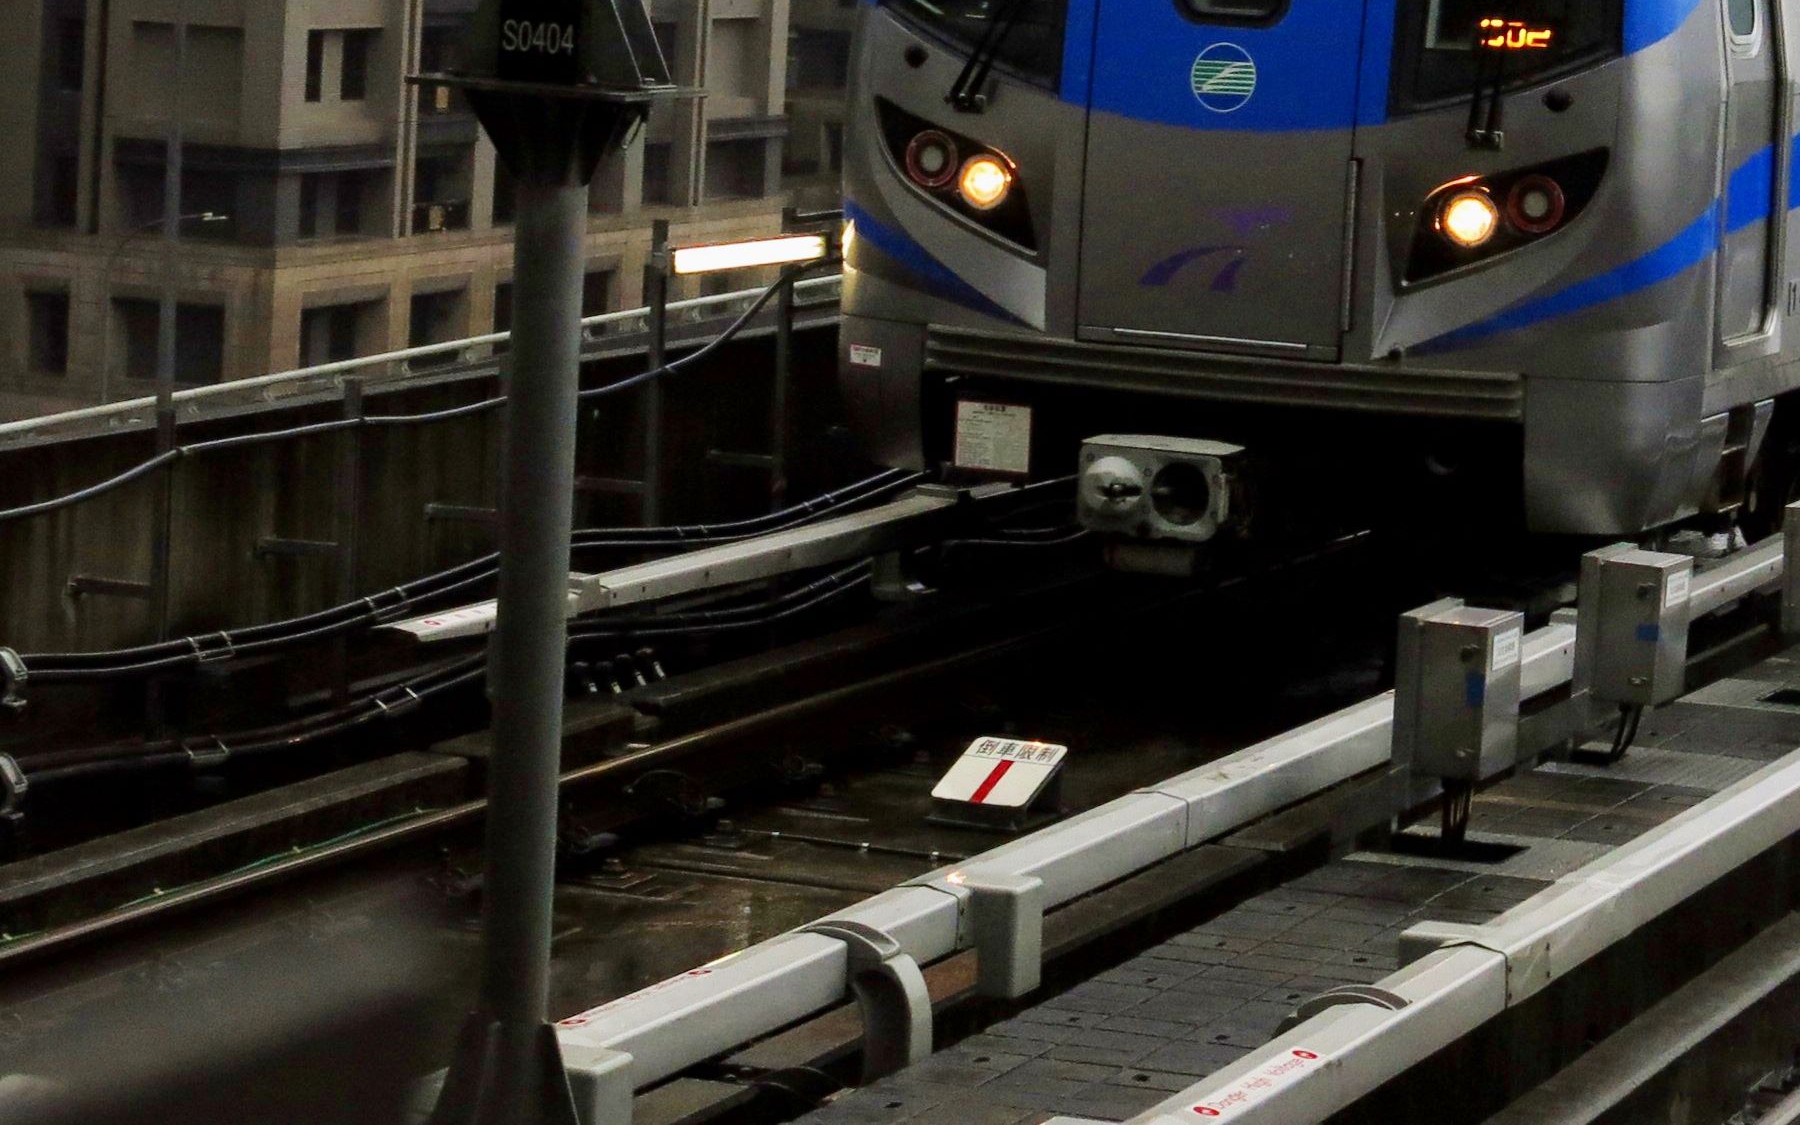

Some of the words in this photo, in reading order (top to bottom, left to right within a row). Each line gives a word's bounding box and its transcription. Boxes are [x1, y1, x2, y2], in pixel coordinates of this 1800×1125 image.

[502, 19, 574, 56] S0404
[976, 739, 1060, 763] 倒車限制
